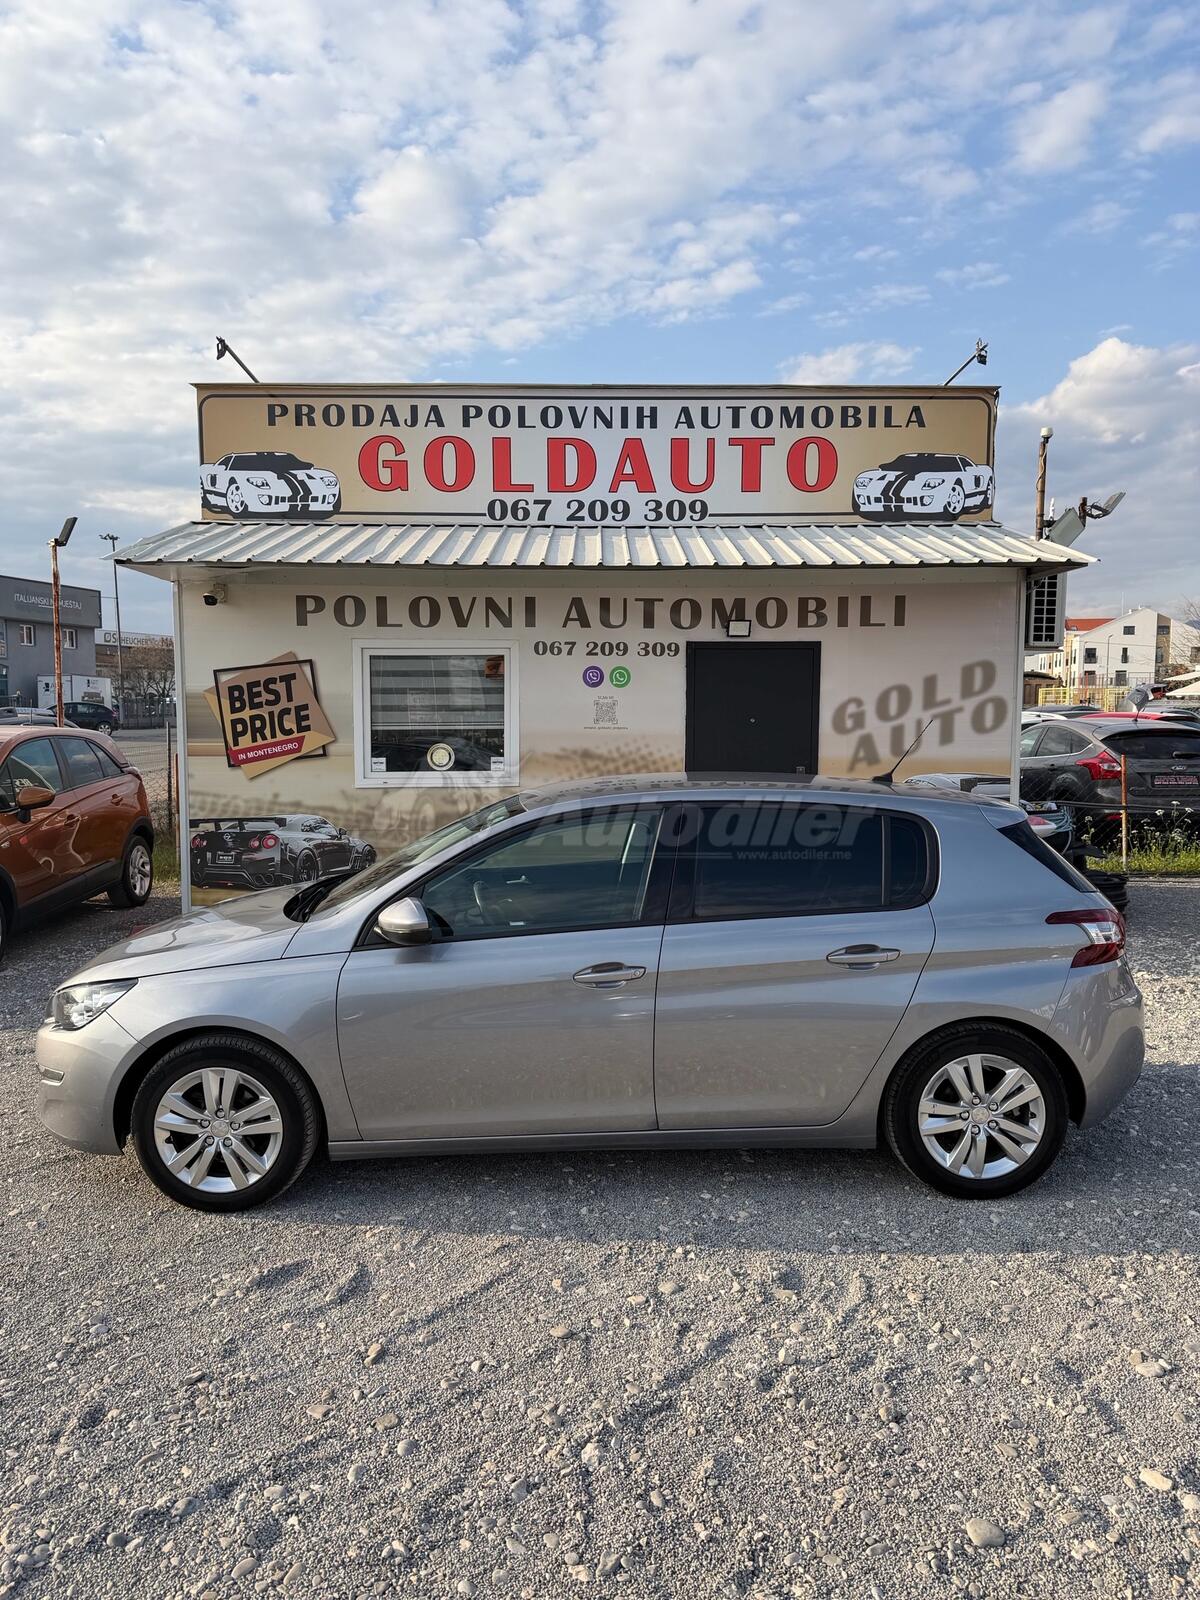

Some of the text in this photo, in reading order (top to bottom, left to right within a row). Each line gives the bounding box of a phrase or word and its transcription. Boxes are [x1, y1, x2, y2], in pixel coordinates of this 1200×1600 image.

[267, 404, 926, 429] PRODAJA POLOVNIH AUTOMOBILA
[358, 435, 838, 493] GOLDAUTO
[487, 499, 709, 522] 067 209 309
[295, 595, 907, 629] POLOVNI AUTOMOBILI
[533, 641, 681, 657] 067 209 309
[227, 673, 297, 714] BEST
[831, 659, 996, 735] GOLD
[230, 703, 312, 747] PRICE
[846, 695, 1008, 773] AUTO
[238, 742, 299, 760] IN MONTENEGRO
